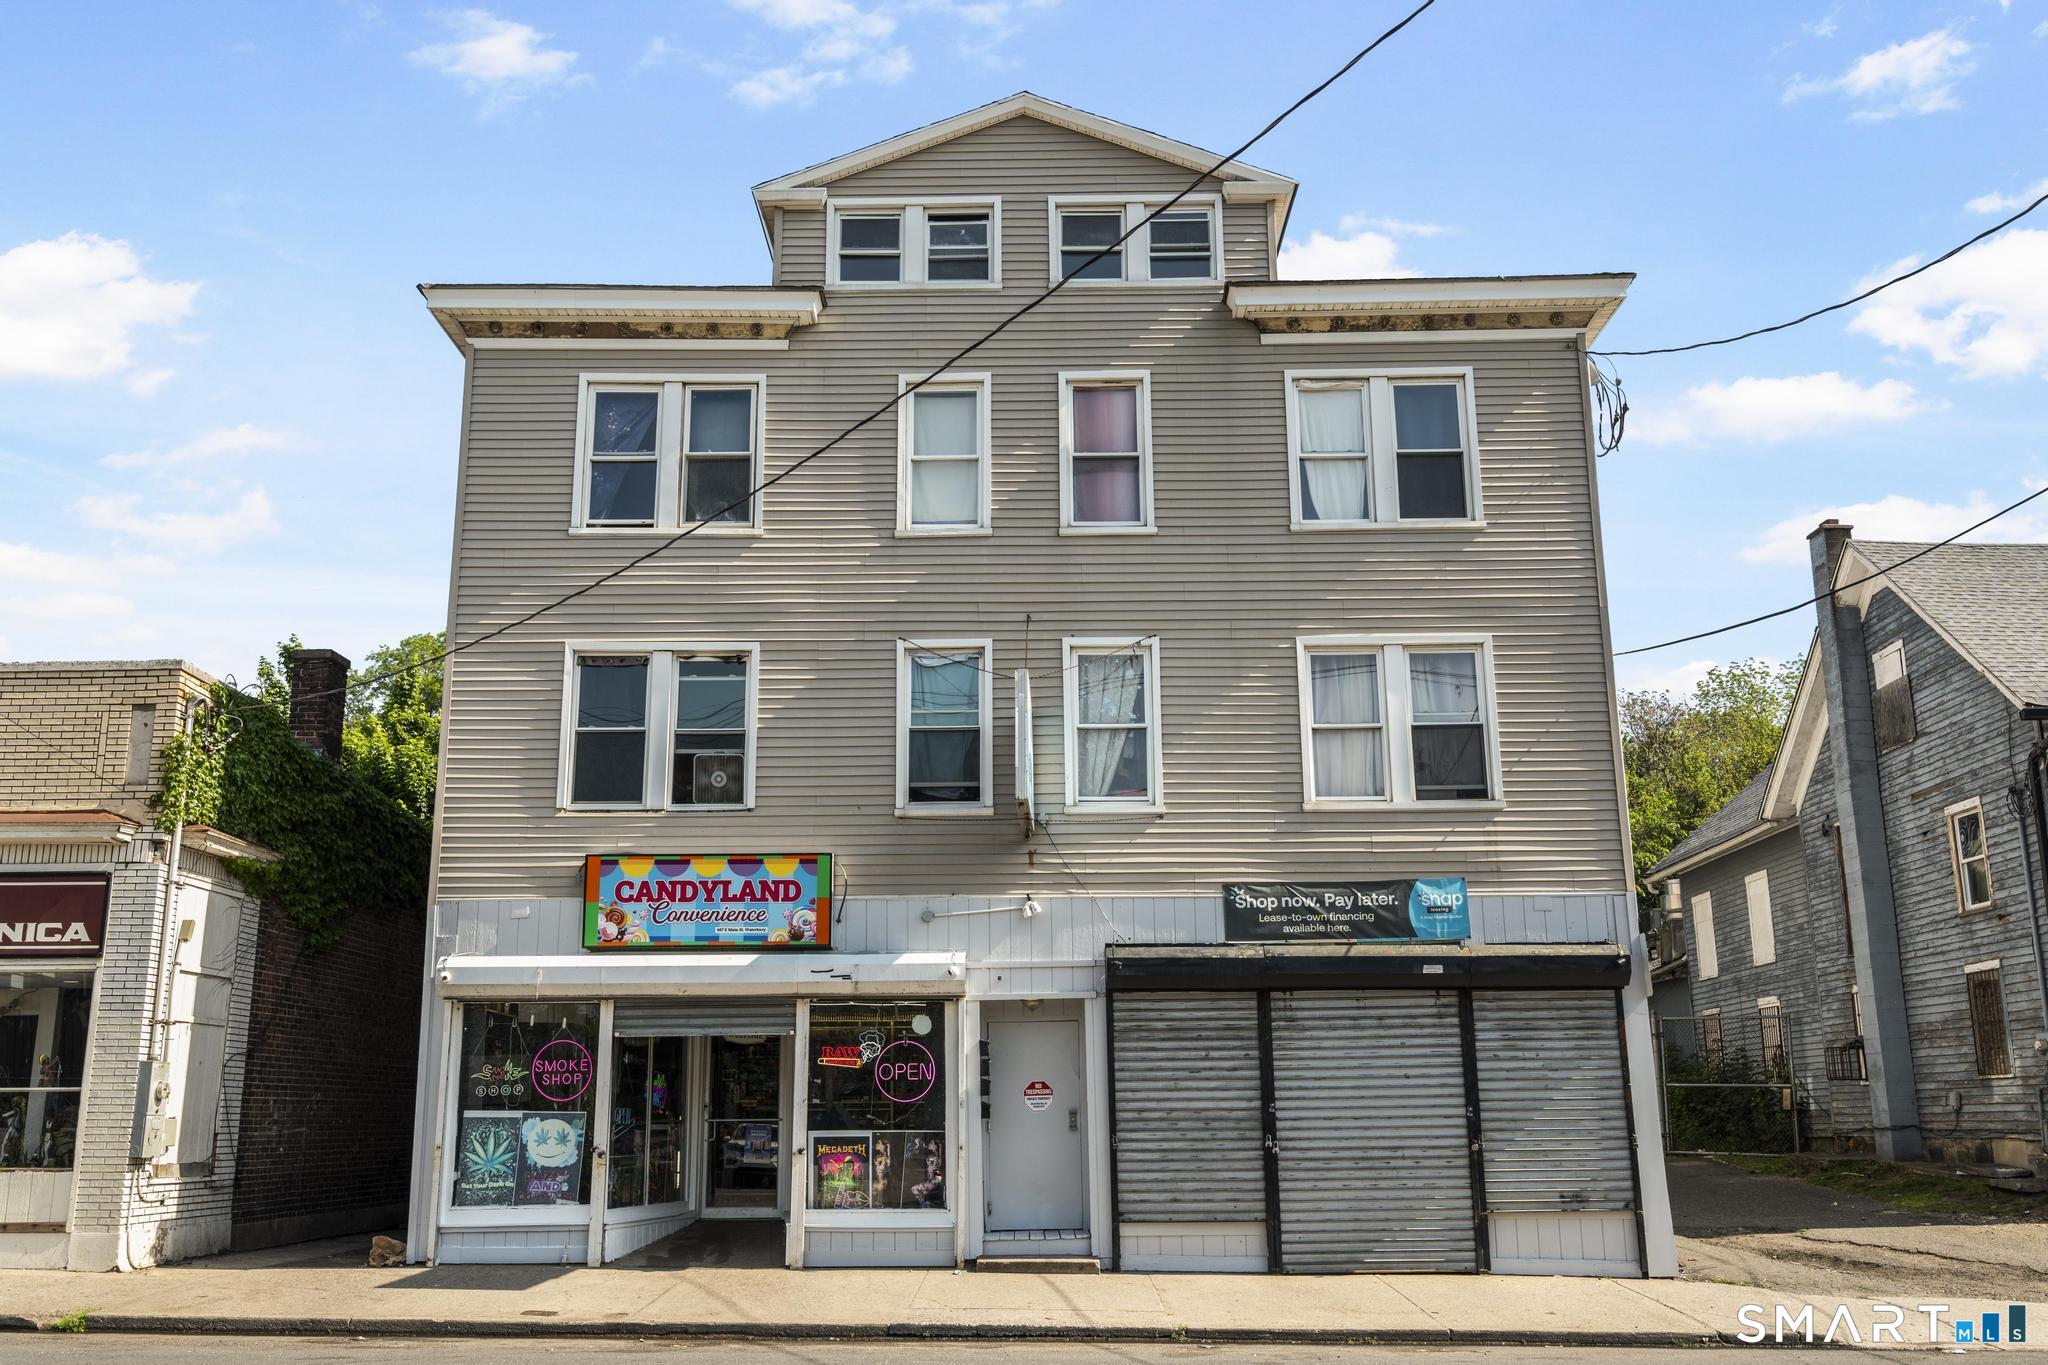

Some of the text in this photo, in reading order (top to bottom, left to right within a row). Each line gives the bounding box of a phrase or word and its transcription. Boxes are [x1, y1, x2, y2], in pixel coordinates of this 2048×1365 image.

[614, 880, 802, 903] CANDYLAND
[1235, 892, 1399, 911] Shop now. Pay later.
[1421, 893, 1463, 910] snap
[648, 900, 768, 924] Convenience
[1258, 912, 1375, 923] Lease-to-own financing
[0, 922, 92, 943] NICA
[1283, 923, 1352, 933] available here.
[821, 1046, 861, 1058] RAW
[535, 1058, 589, 1072] SMOKE
[879, 1062, 932, 1081] OPEN
[542, 1073, 583, 1085] SHOP
[477, 1085, 523, 1096] SHOP
[817, 1144, 867, 1157] MEGADETH
[529, 1180, 561, 1192] AND
